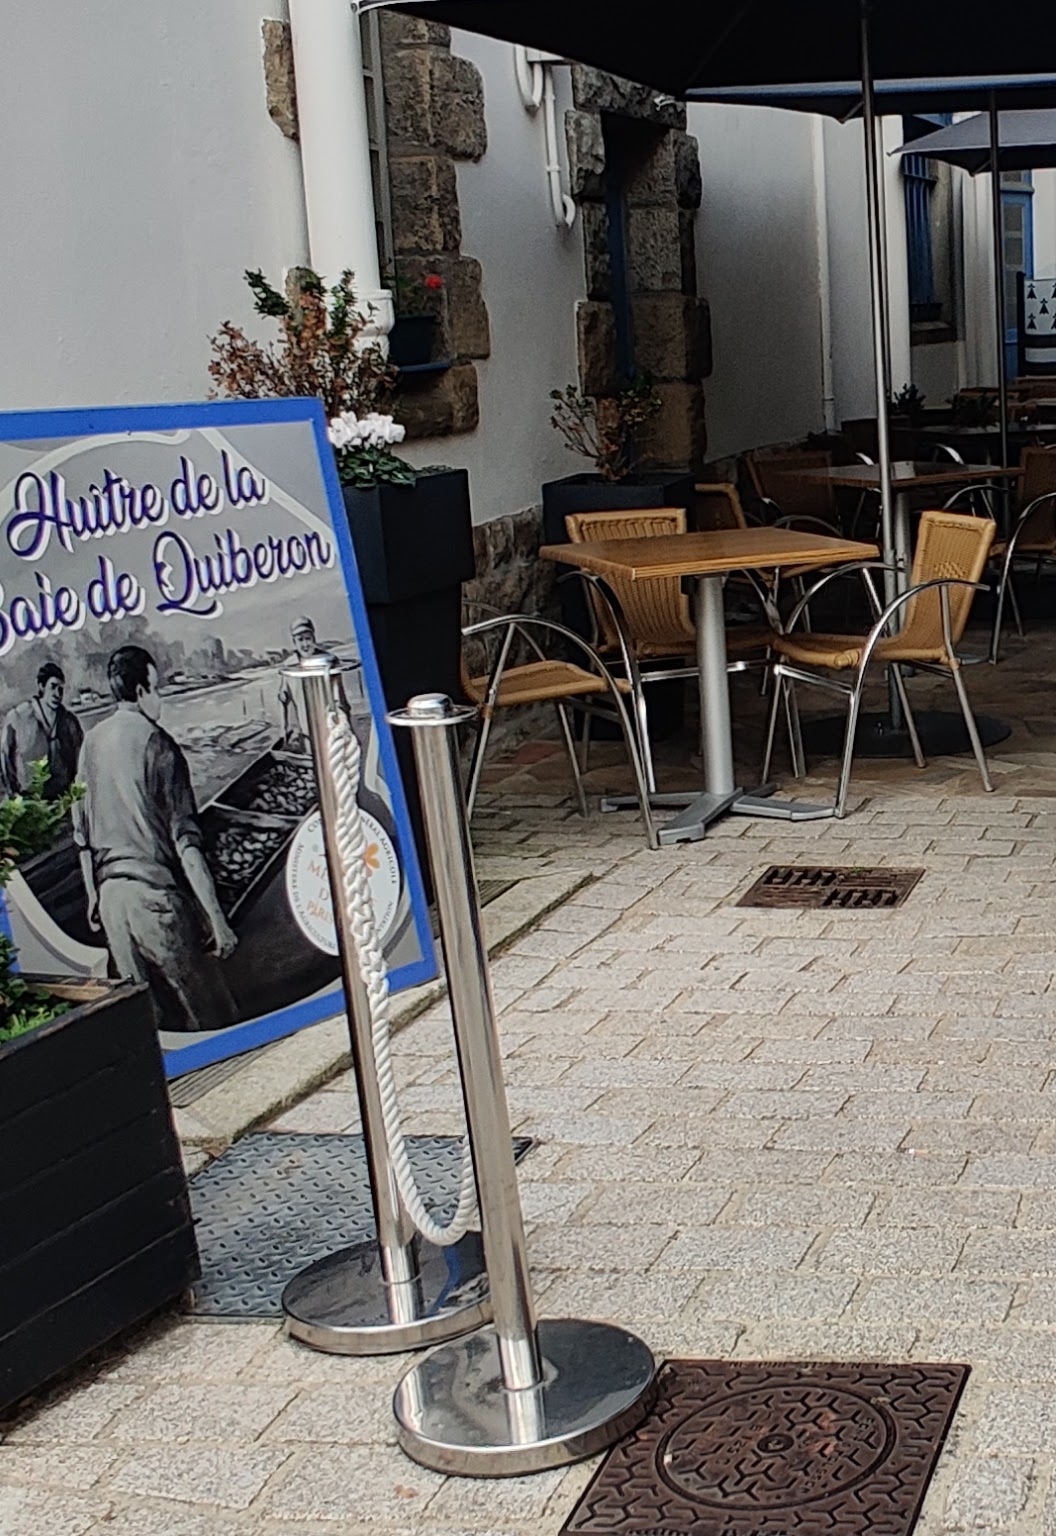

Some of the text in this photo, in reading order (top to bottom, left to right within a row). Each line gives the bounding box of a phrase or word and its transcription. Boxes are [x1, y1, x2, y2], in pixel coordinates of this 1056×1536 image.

[7, 449, 267, 557] Huître de la
[88, 555, 142, 620] de
[153, 528, 333, 617] Quiberon
